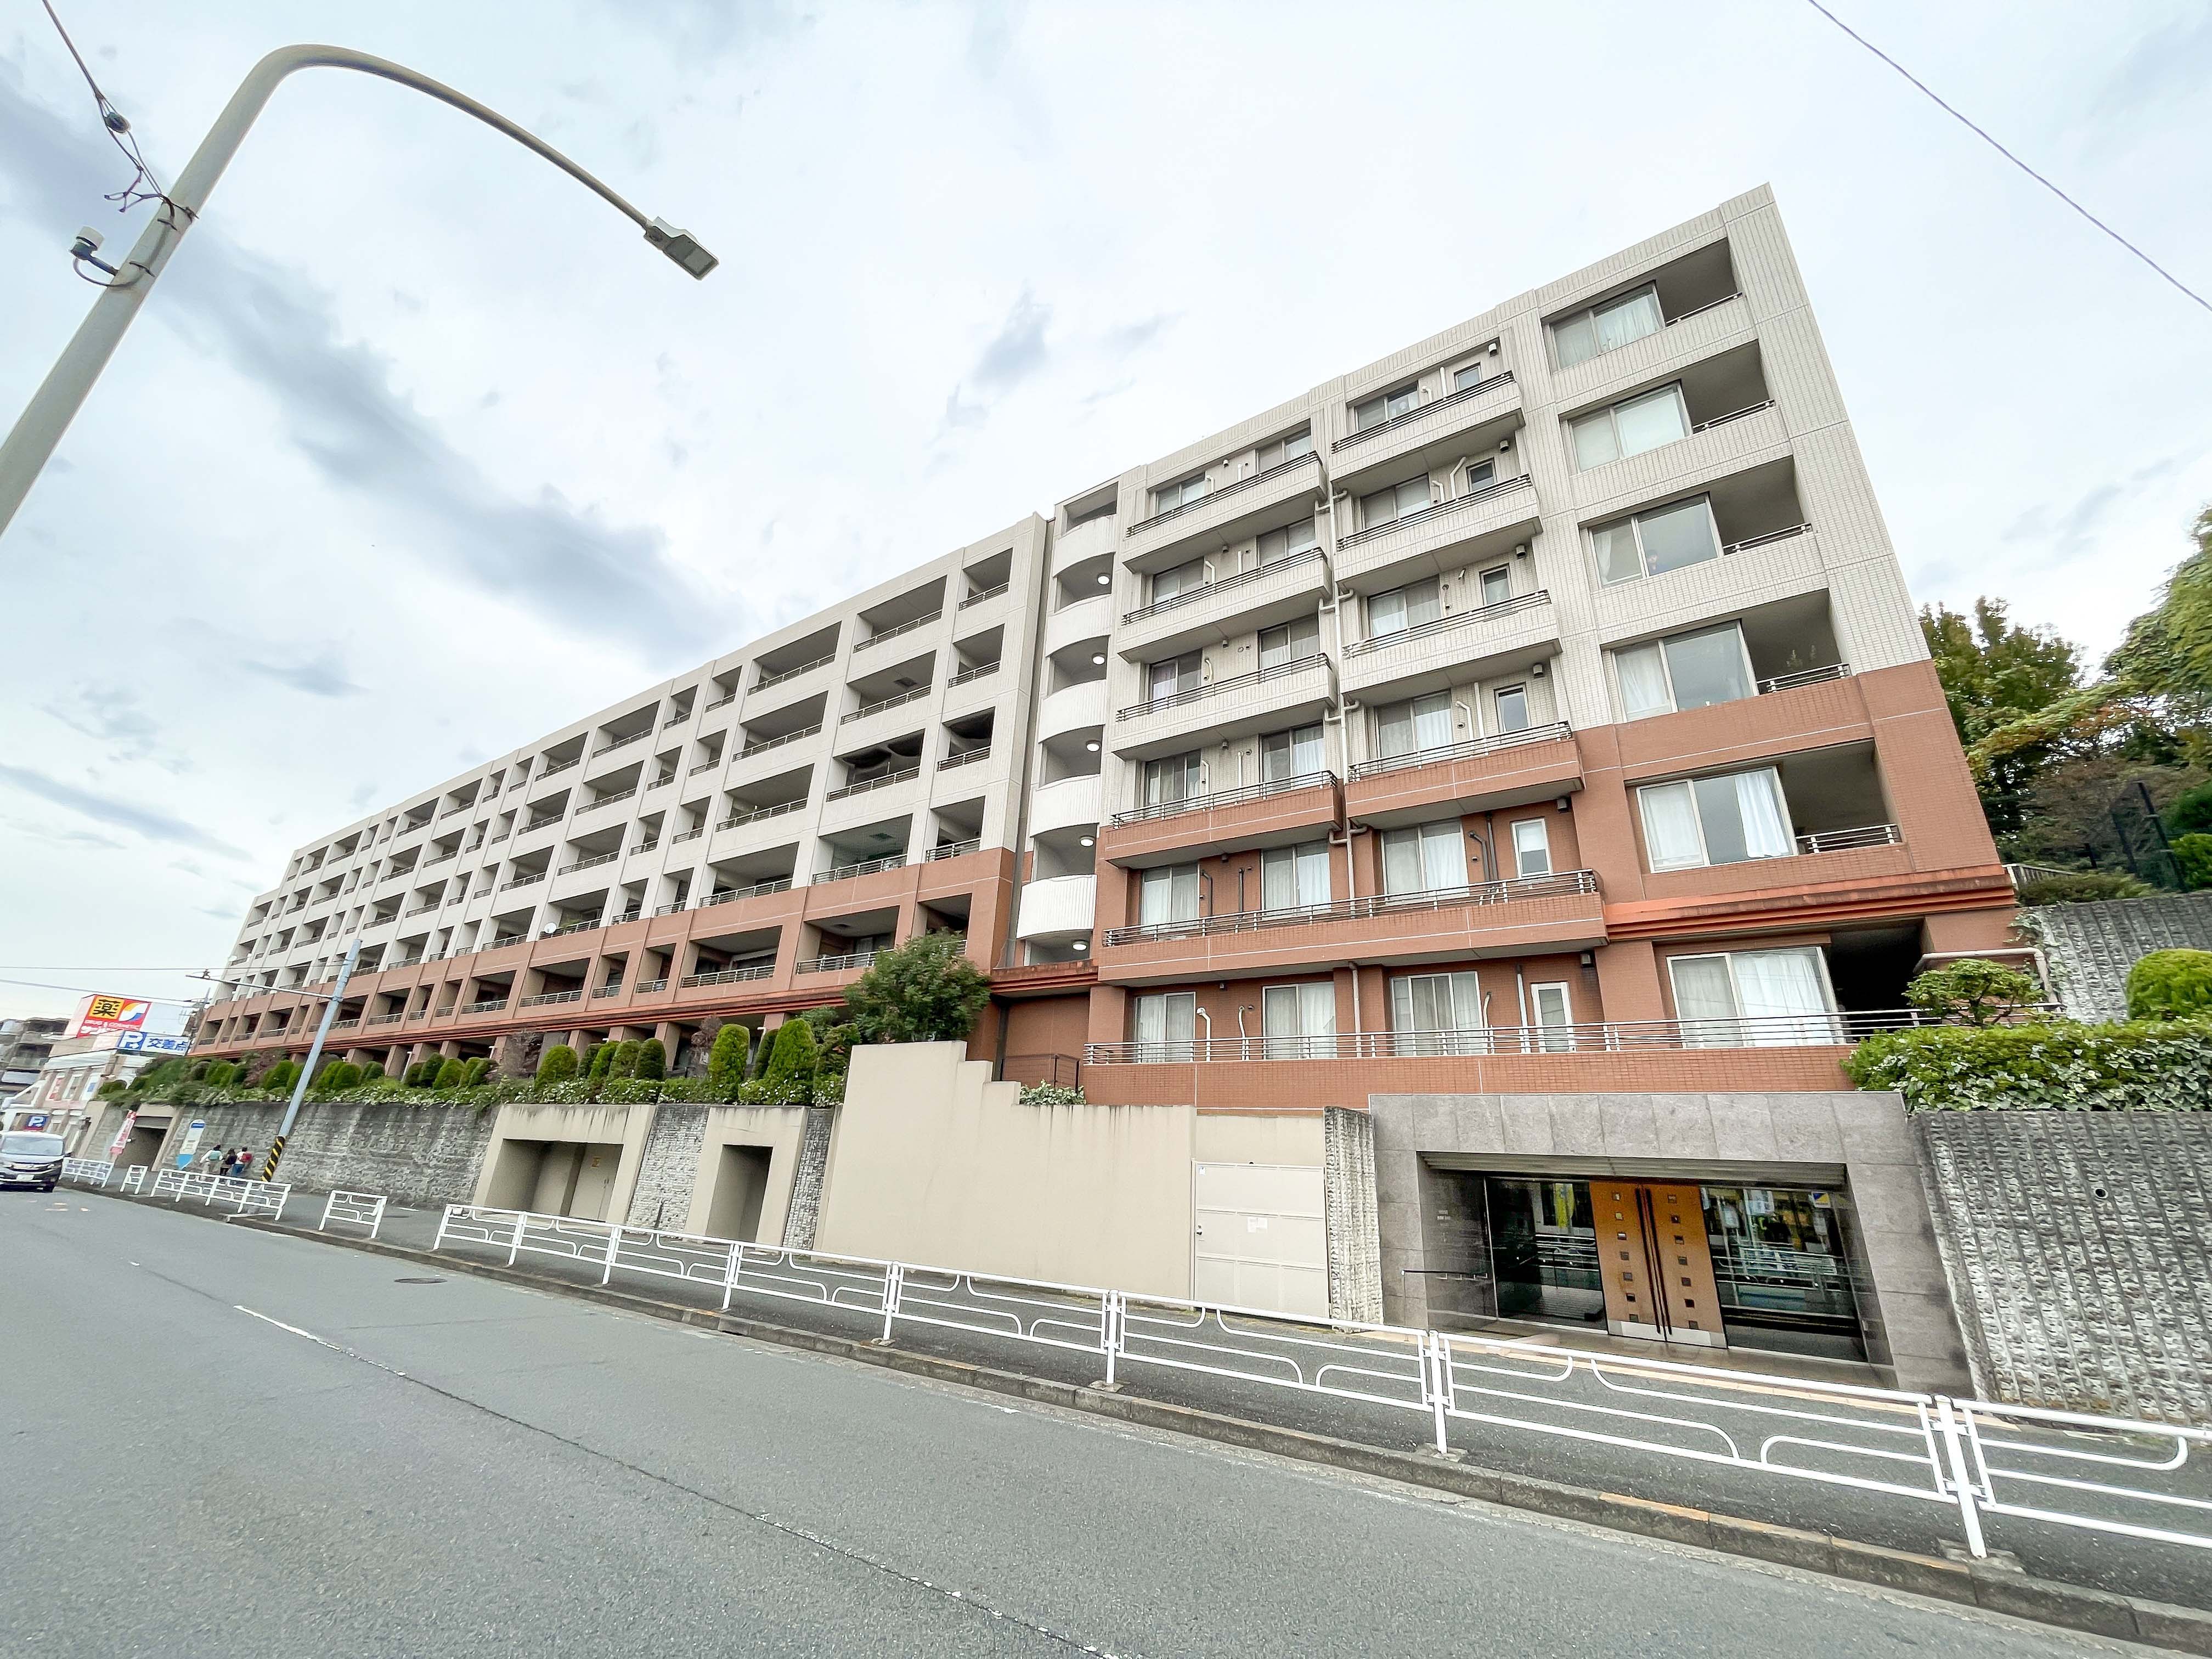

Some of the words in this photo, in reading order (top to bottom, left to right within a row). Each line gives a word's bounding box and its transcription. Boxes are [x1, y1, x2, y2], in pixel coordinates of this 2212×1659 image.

[93, 1000, 120, 1016] 薬
[119, 1030, 144, 1048] P
[147, 1039, 188, 1051] 交差点
